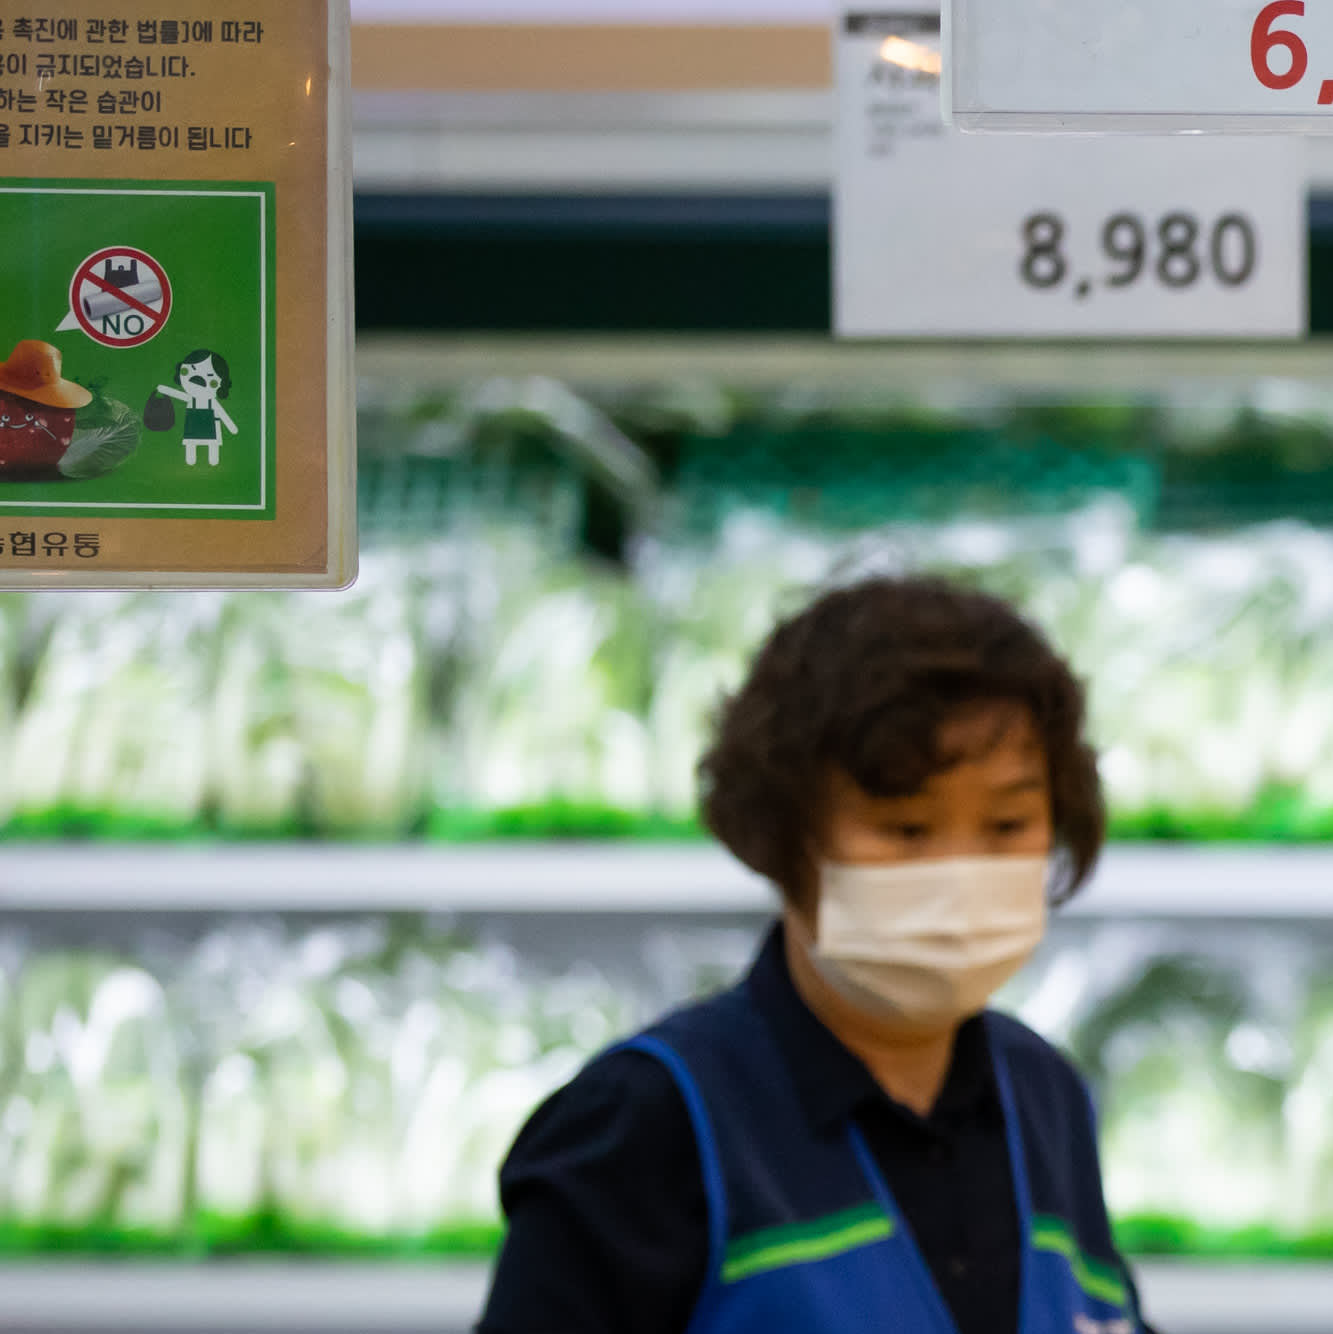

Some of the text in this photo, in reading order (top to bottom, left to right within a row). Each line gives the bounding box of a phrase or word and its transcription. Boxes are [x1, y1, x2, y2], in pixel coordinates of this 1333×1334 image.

[13, 18, 77, 42] 촉진에
[86, 19, 128, 43] 관한
[221, 21, 264, 43] 따라
[0, 53, 196, 79] 이 금지되었습니다.
[45, 89, 88, 113] 작은
[97, 90, 161, 114] 습관이
[19, 124, 84, 149] 지키는
[92, 125, 178, 150] 밑거름이
[187, 127, 252, 151] 됩니다
[1020, 211, 1257, 300] 8,980
[102, 314, 145, 336] NO
[0, 531, 101, 558] 협유통
